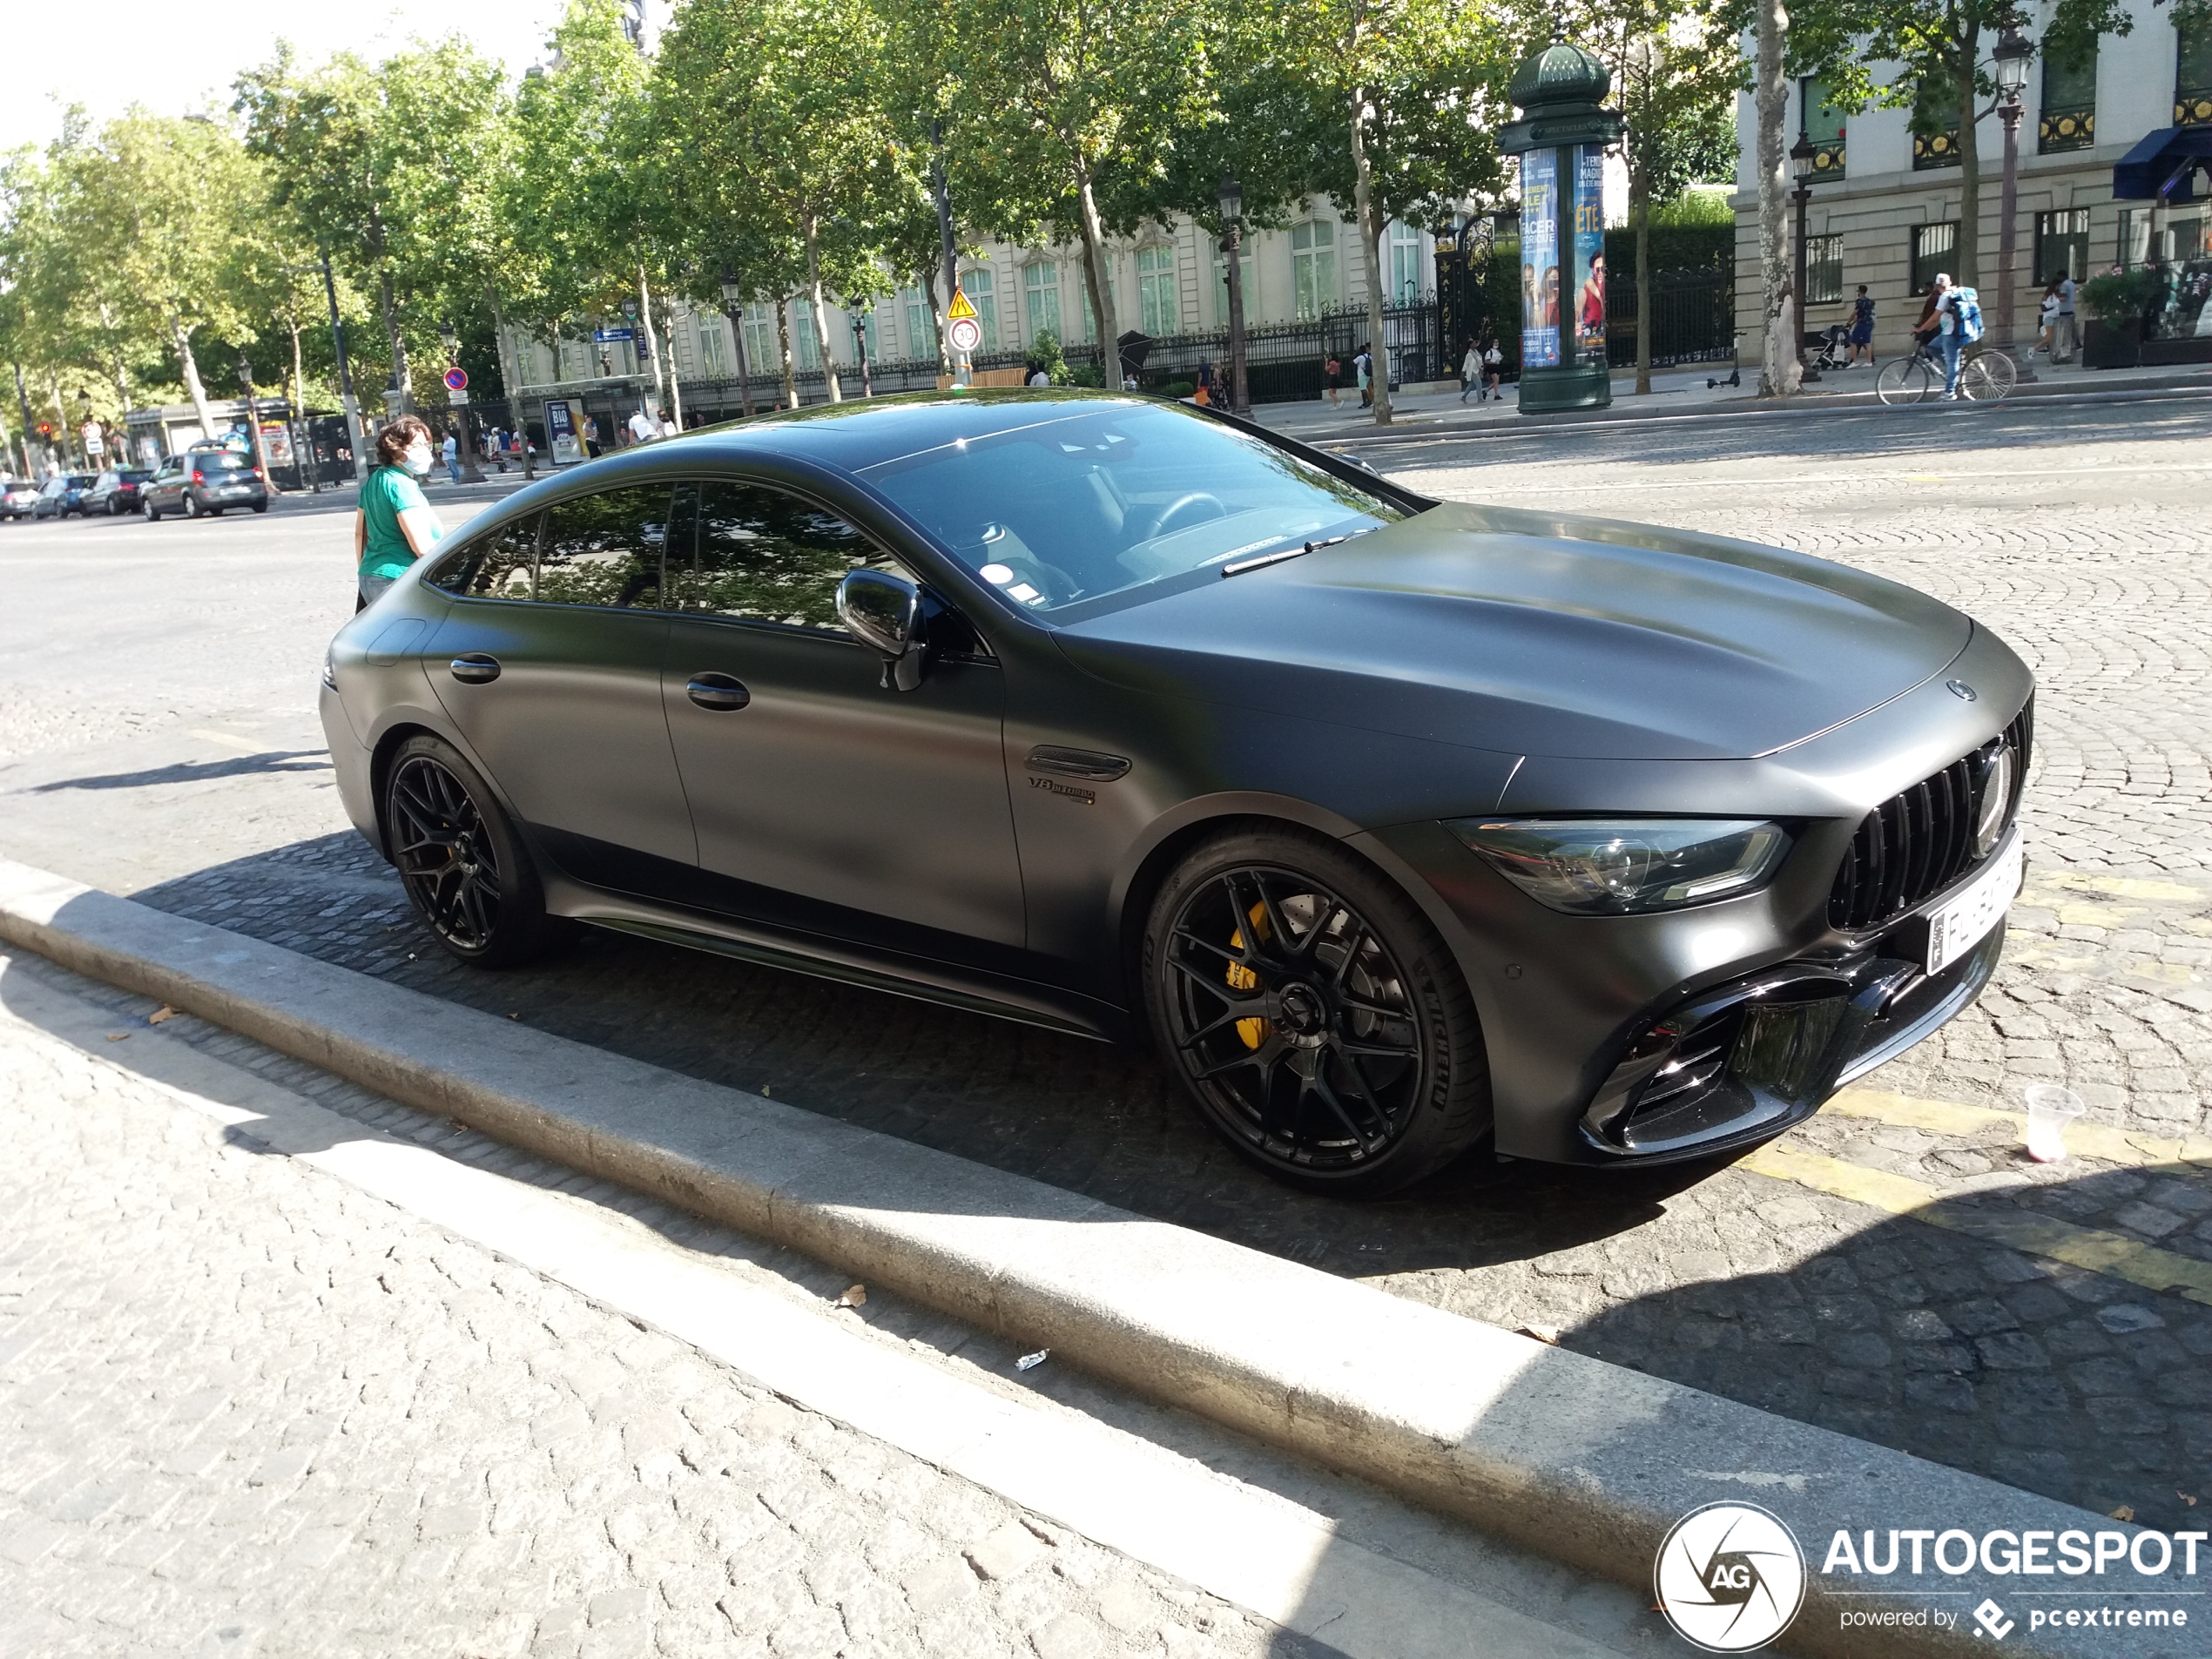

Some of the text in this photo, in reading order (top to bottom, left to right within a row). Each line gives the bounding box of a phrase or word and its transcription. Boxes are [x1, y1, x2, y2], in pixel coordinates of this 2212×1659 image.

[1544, 125, 1587, 133] SPECTACLES
[1575, 202, 1599, 233] ÉTÉ
[957, 327, 974, 341] 30
[552, 409, 568, 424] BIO
[1028, 778, 1096, 799] V8 BITURBO
[1933, 948, 1942, 961] F
[1425, 992, 1449, 1108] MICHELIN
